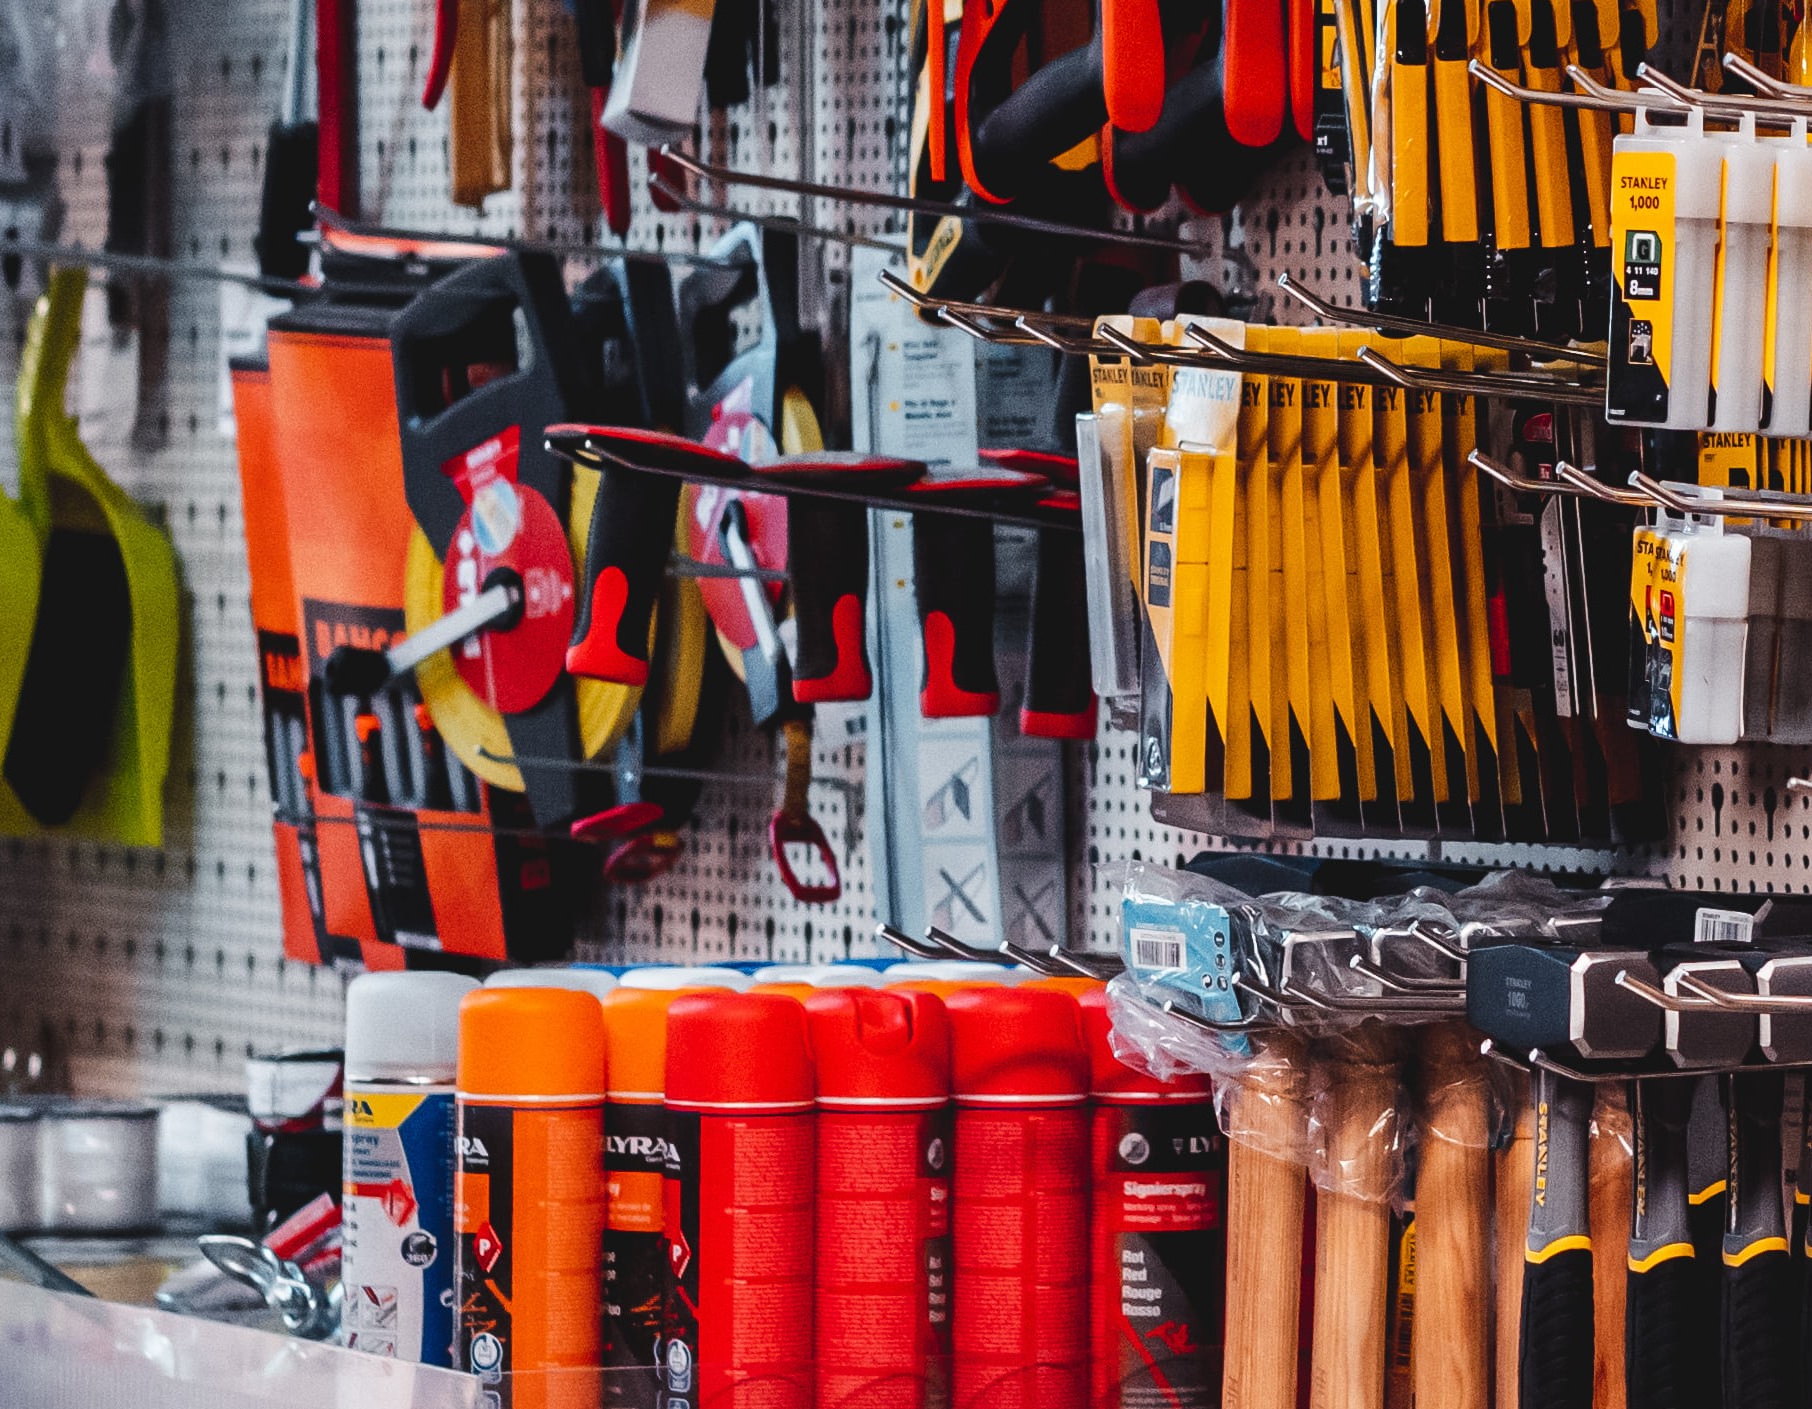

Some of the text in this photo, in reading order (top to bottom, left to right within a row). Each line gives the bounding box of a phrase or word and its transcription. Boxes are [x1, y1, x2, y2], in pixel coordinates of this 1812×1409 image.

[1620, 176, 1669, 190] STANLEY
[1629, 195, 1660, 212] 1,000
[1092, 367, 1129, 384] STANLEY
[1172, 370, 1236, 402] STANLEY
[1703, 431, 1752, 450] STANLEY
[1535, 1102, 1549, 1208] STANLEY
[1121, 1249, 1145, 1264] Rot
[1121, 1267, 1148, 1282] Red
[1121, 1285, 1163, 1302] Rouge
[1121, 1302, 1161, 1317] Rosso
